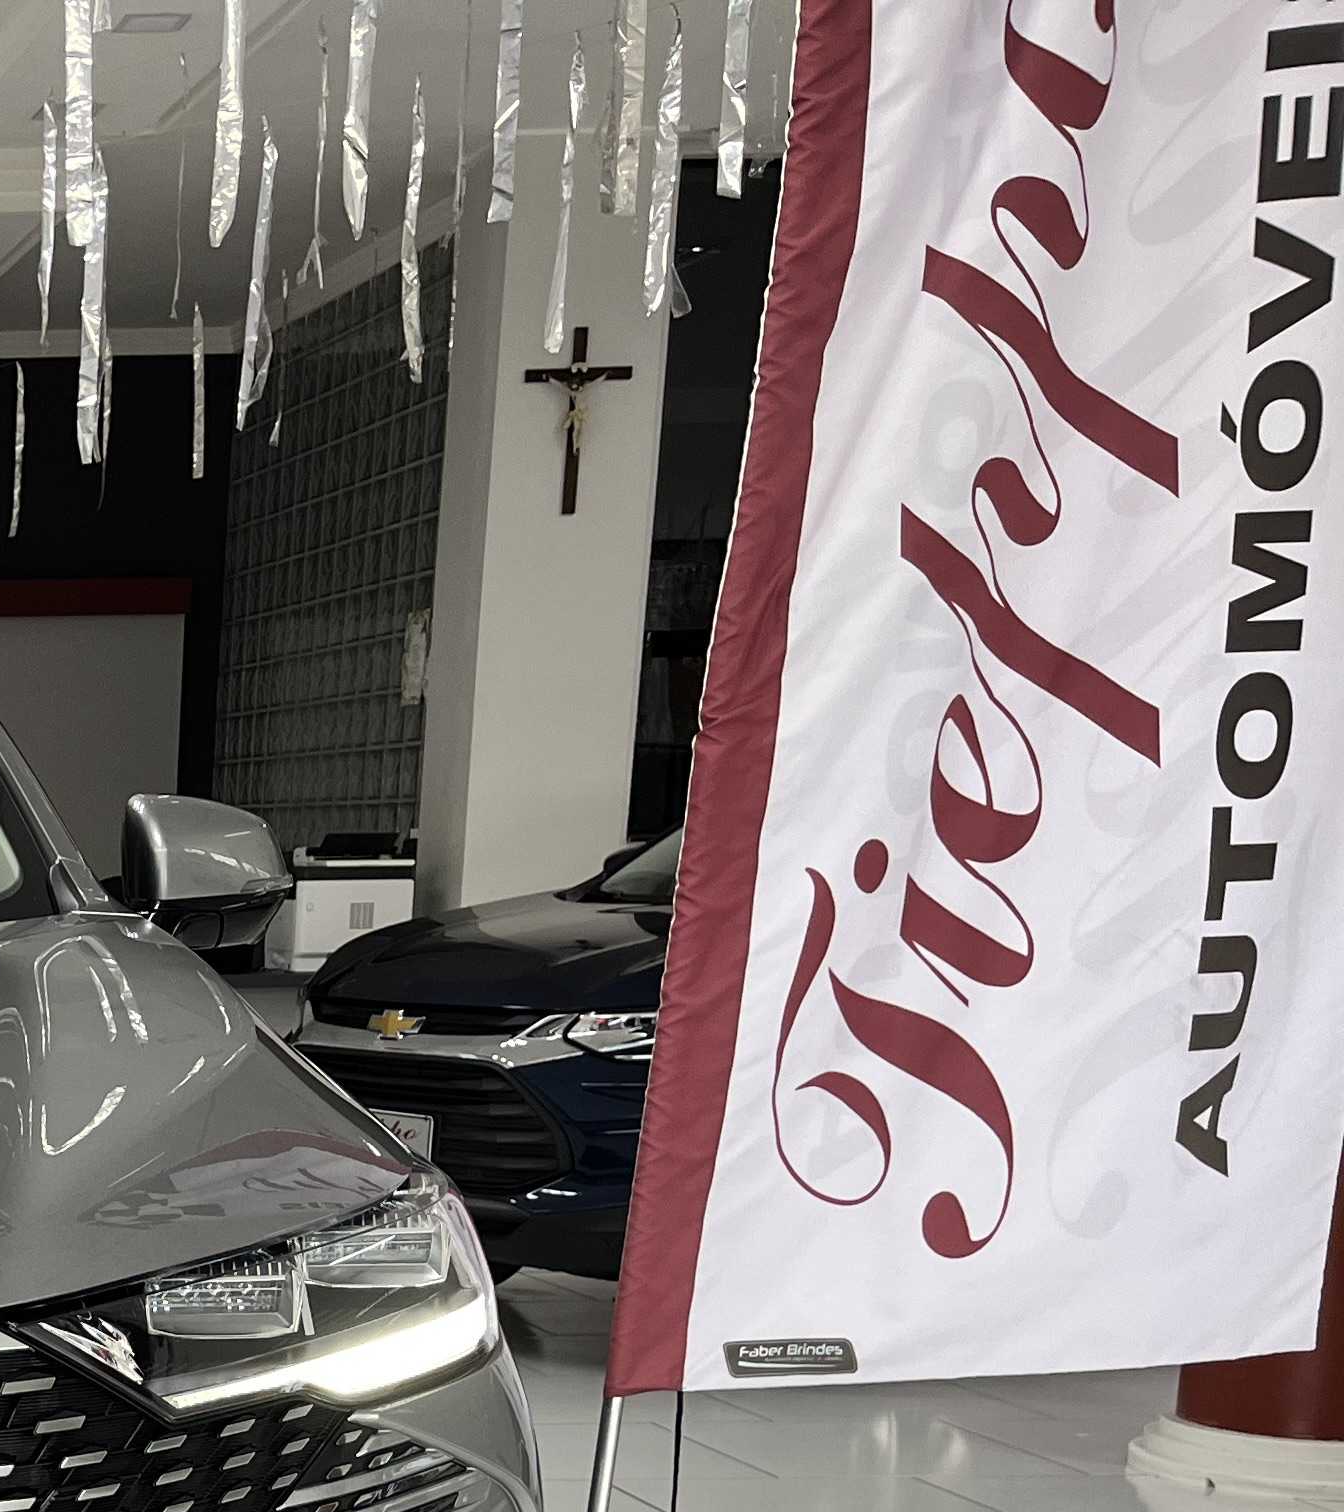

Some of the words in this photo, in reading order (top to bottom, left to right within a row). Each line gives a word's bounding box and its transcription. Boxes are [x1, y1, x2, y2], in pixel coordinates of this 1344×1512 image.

[1174, 0, 1344, 1178] AUTOMÓVEI
[739, 1345, 784, 1358] Faber
[786, 1343, 844, 1356] Brindes
